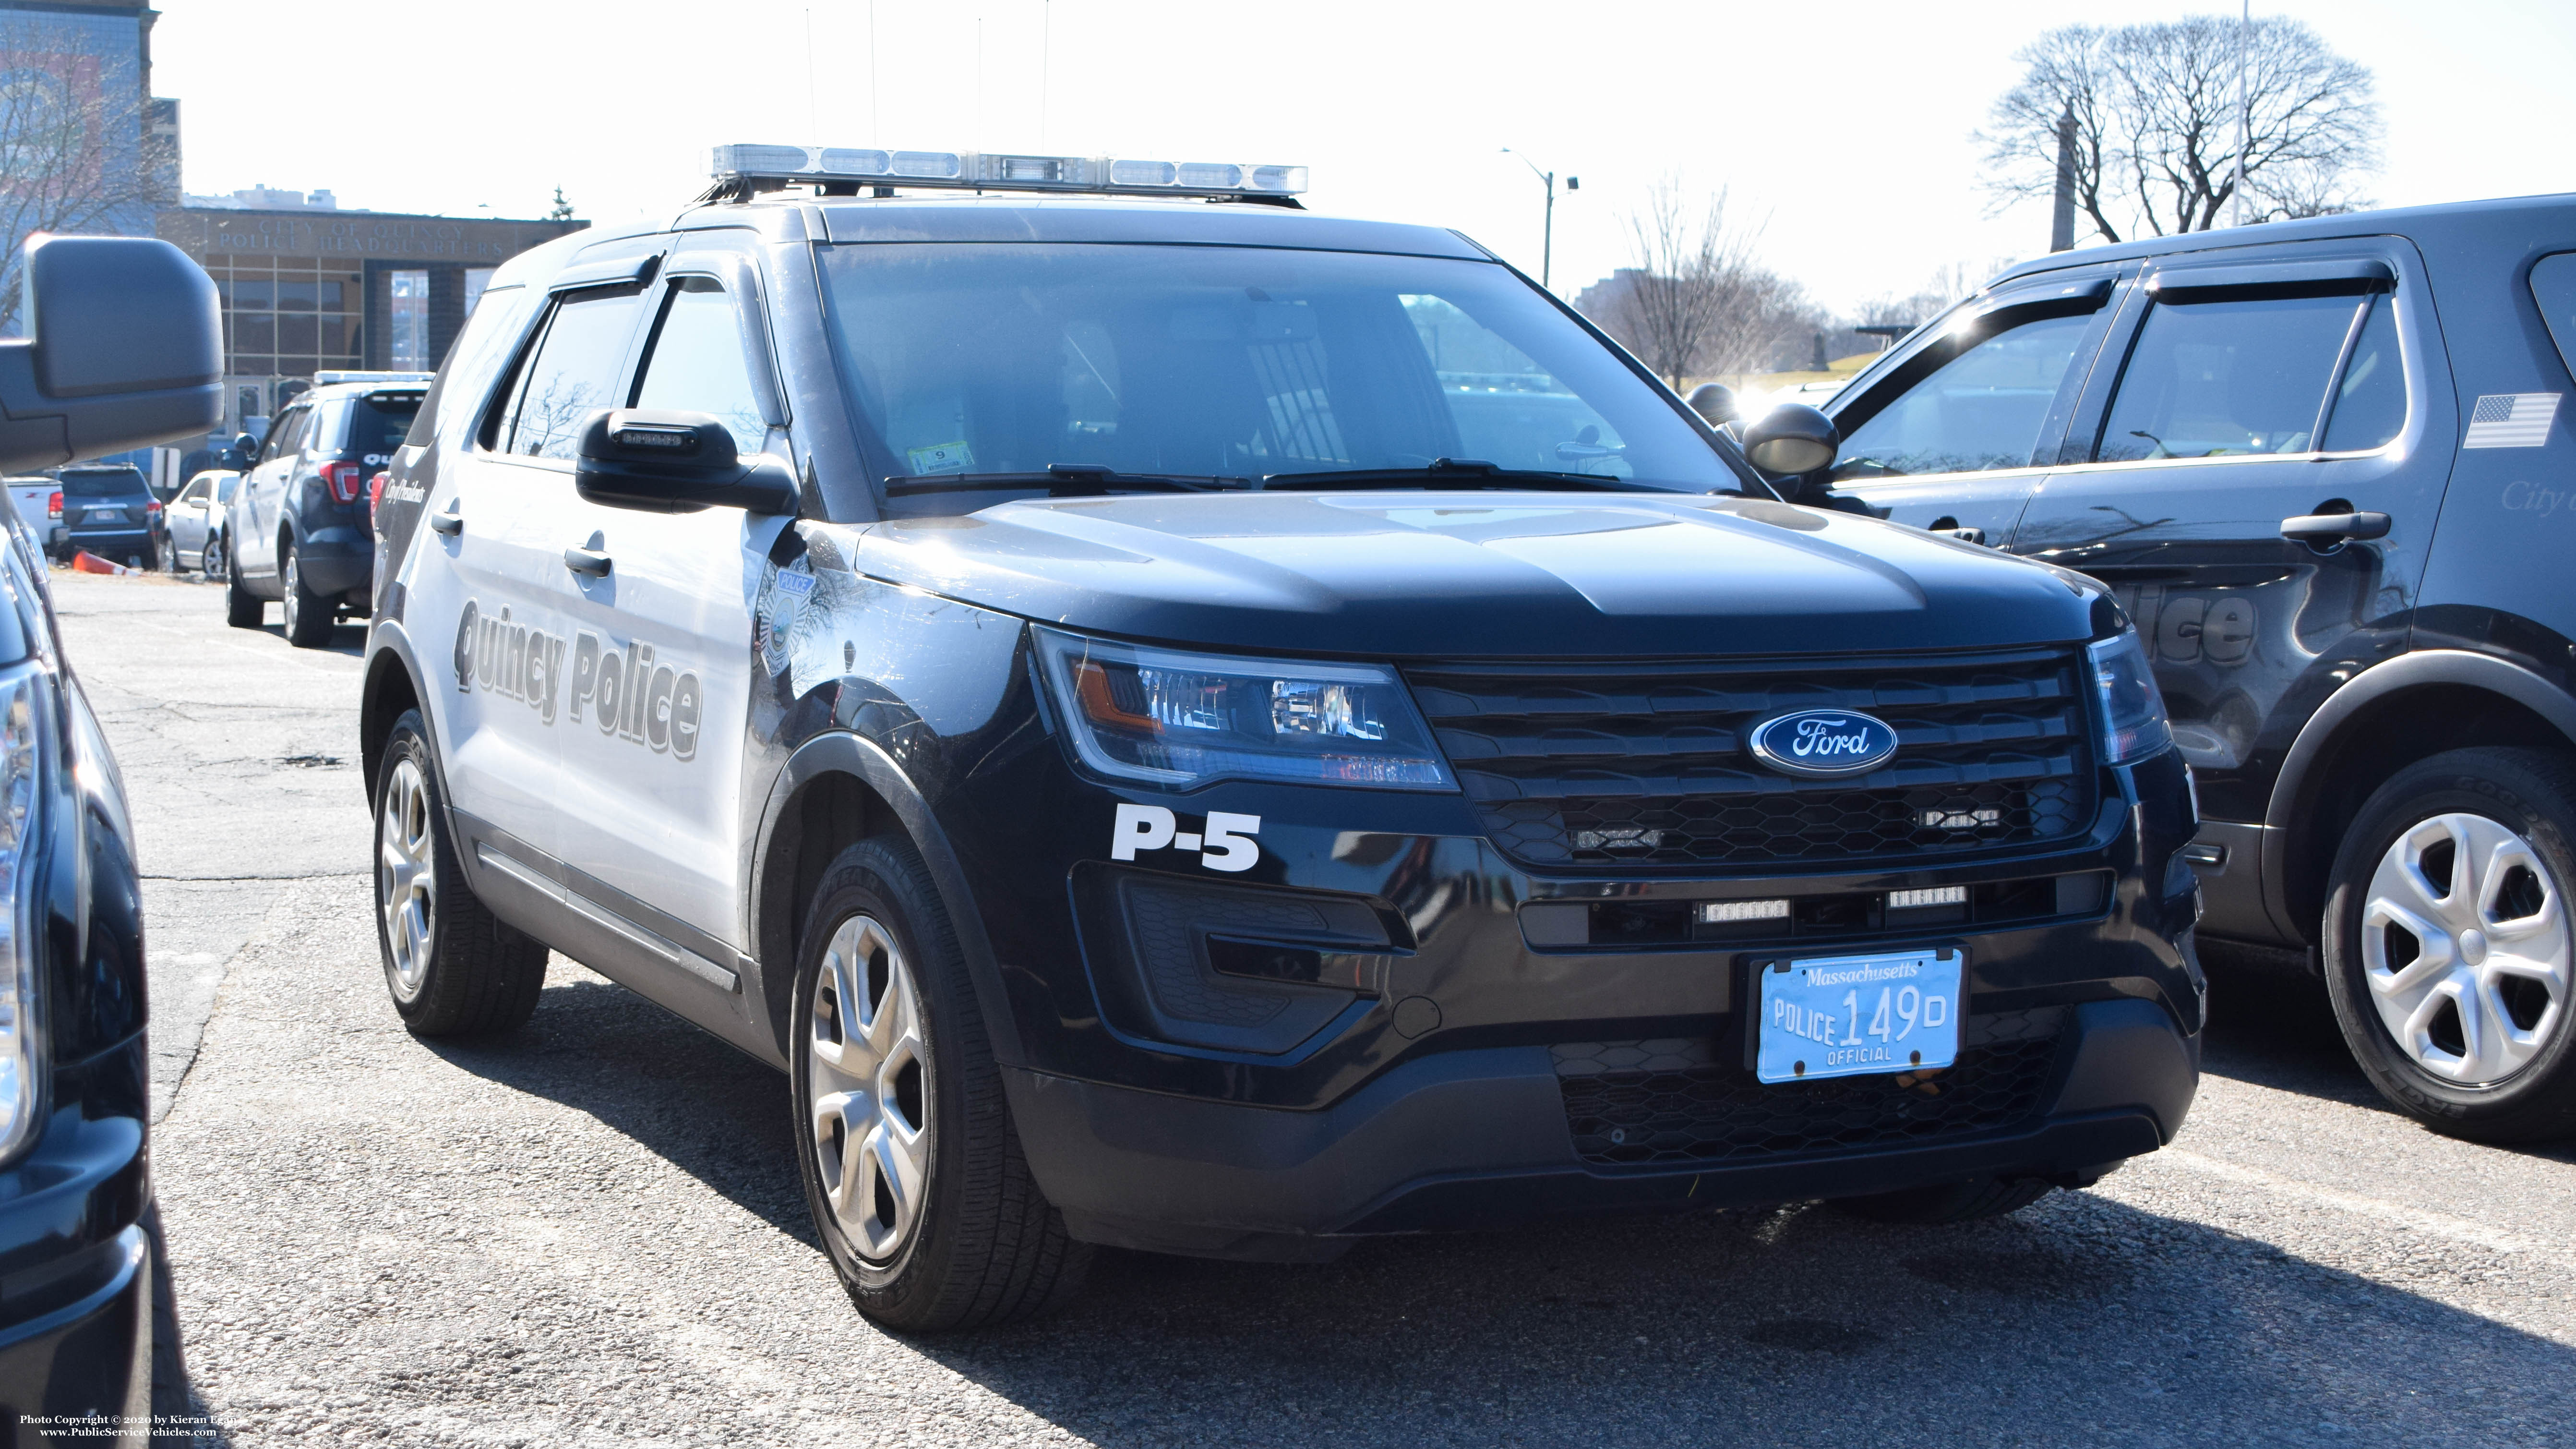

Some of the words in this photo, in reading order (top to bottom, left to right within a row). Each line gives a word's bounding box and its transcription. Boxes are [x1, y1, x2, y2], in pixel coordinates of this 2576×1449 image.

[259, 220, 315, 235] CITY
[332, 222, 357, 236] OF
[373, 224, 465, 240] QUINCY
[220, 233, 297, 251] POLICE
[319, 237, 503, 256] HEADQUARTERS
[2501, 481, 2565, 518] City
[780, 574, 808, 592] POLICE
[766, 656, 783, 671] QUINCY
[454, 596, 567, 726] Quincy
[569, 628, 703, 762] Police
[1793, 719, 1869, 756] Ford
[1111, 803, 1261, 872] P-5
[1807, 963, 1917, 987] Massachusetts
[1774, 999, 1836, 1047] POLICE
[1827, 1047, 1892, 1067] OFFICIAL
